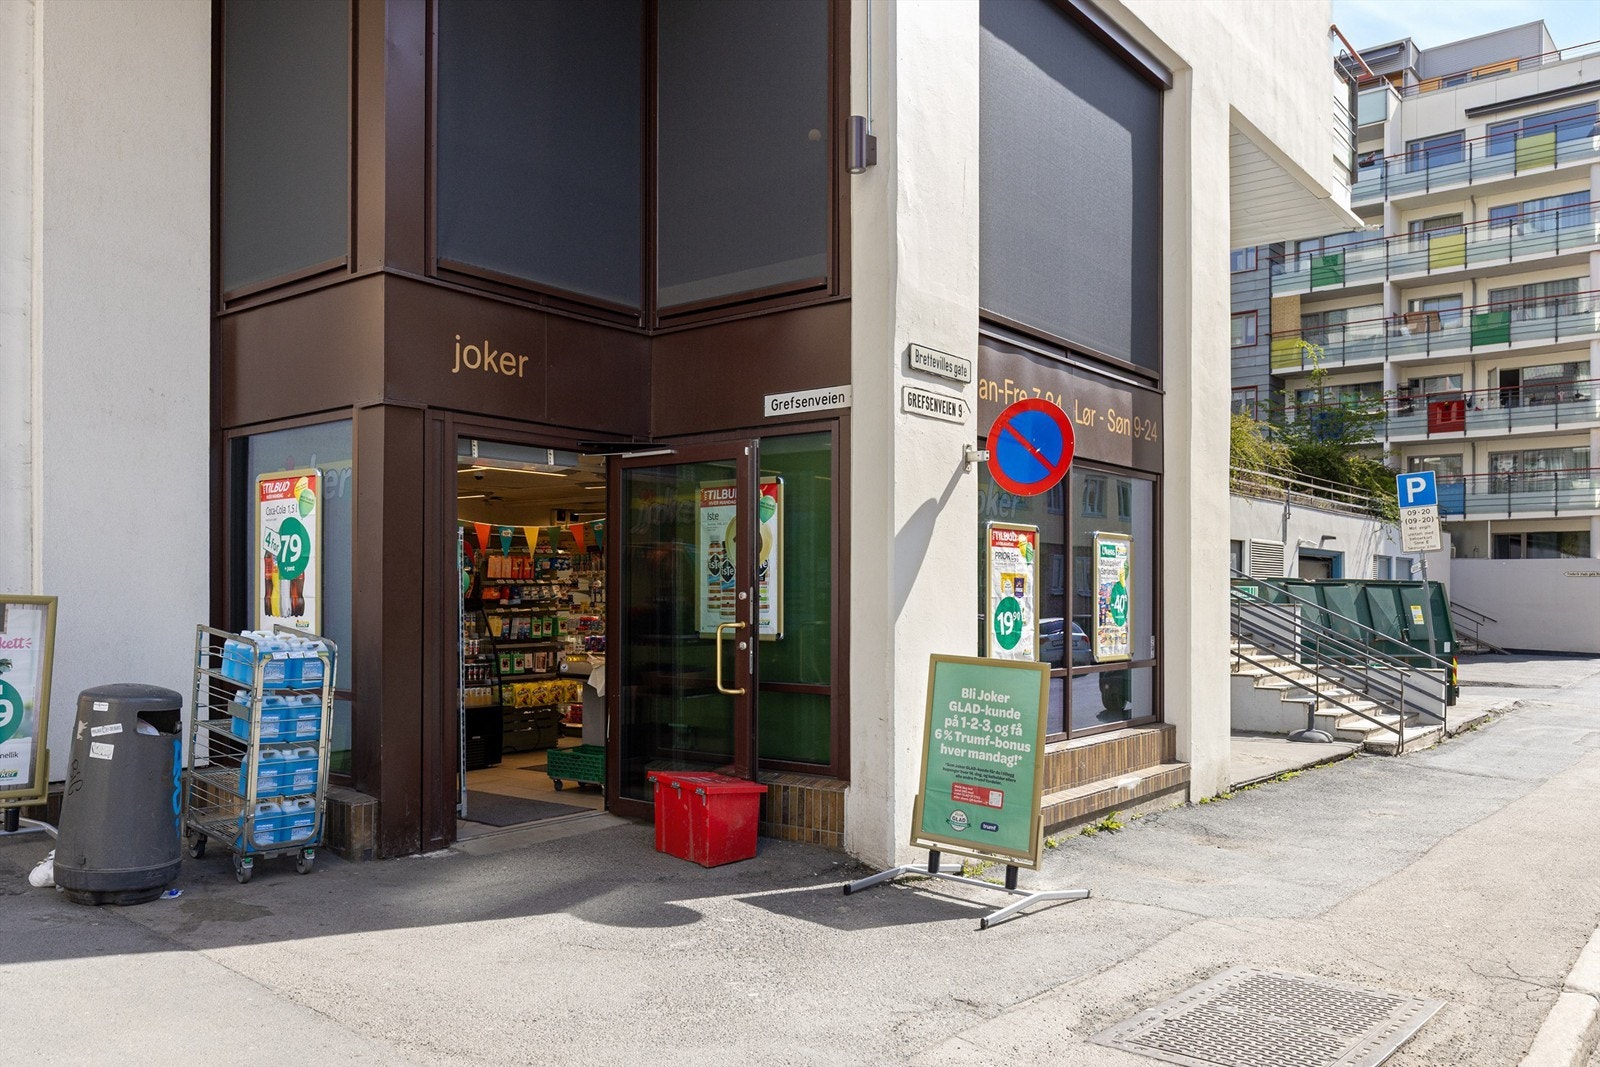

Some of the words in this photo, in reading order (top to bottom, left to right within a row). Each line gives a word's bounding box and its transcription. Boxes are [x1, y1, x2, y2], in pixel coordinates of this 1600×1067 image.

[452, 334, 529, 378] joker
[915, 348, 953, 373] Brettevilles
[953, 364, 967, 378] gate
[979, 378, 1028, 405] an-Fre
[771, 392, 845, 411] Grefsenveien
[907, 391, 957, 417] GREFSENVEIEN
[1075, 399, 1096, 427] Lør
[1107, 408, 1131, 436] Søn
[1133, 416, 1158, 441] 9-24
[265, 481, 290, 494] TILBUD
[708, 489, 737, 500] TILBU
[1406, 477, 1426, 503] P
[265, 505, 286, 516] Coca-Cola
[265, 531, 271, 547] 4
[280, 533, 302, 563] 79
[0, 637, 25, 649] kett
[961, 687, 976, 699] Bli
[977, 689, 1010, 703] Joker
[0, 699, 14, 728] 9
[949, 701, 1021, 720] GLAD-kunde
[944, 714, 958, 728] på
[961, 716, 993, 733] 1-2-3,
[994, 724, 1009, 737] og
[1010, 723, 1023, 737] få
[940, 743, 967, 757] hver
[954, 731, 1031, 752] Trumf-bonus
[951, 815, 966, 823] GLAD
[982, 823, 997, 831] trumf
